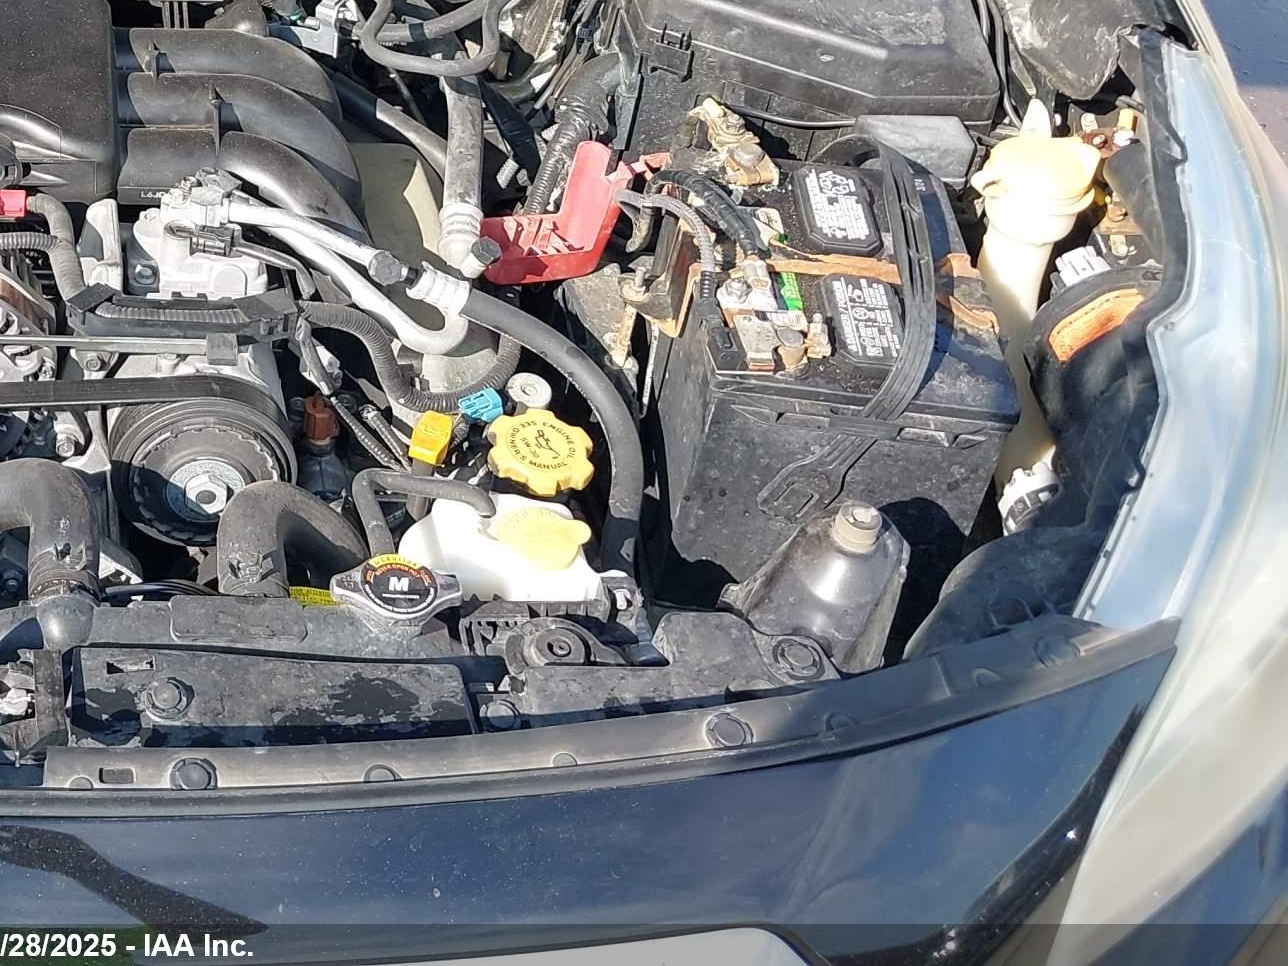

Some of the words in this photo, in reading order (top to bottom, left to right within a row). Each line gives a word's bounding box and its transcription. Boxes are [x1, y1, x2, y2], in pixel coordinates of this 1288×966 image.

[519, 420, 537, 429] SEE
[528, 460, 568, 469] MANUAL
[542, 422, 575, 445] ENGINE
[568, 448, 577, 459] OIL
[388, 576, 410, 592] M
